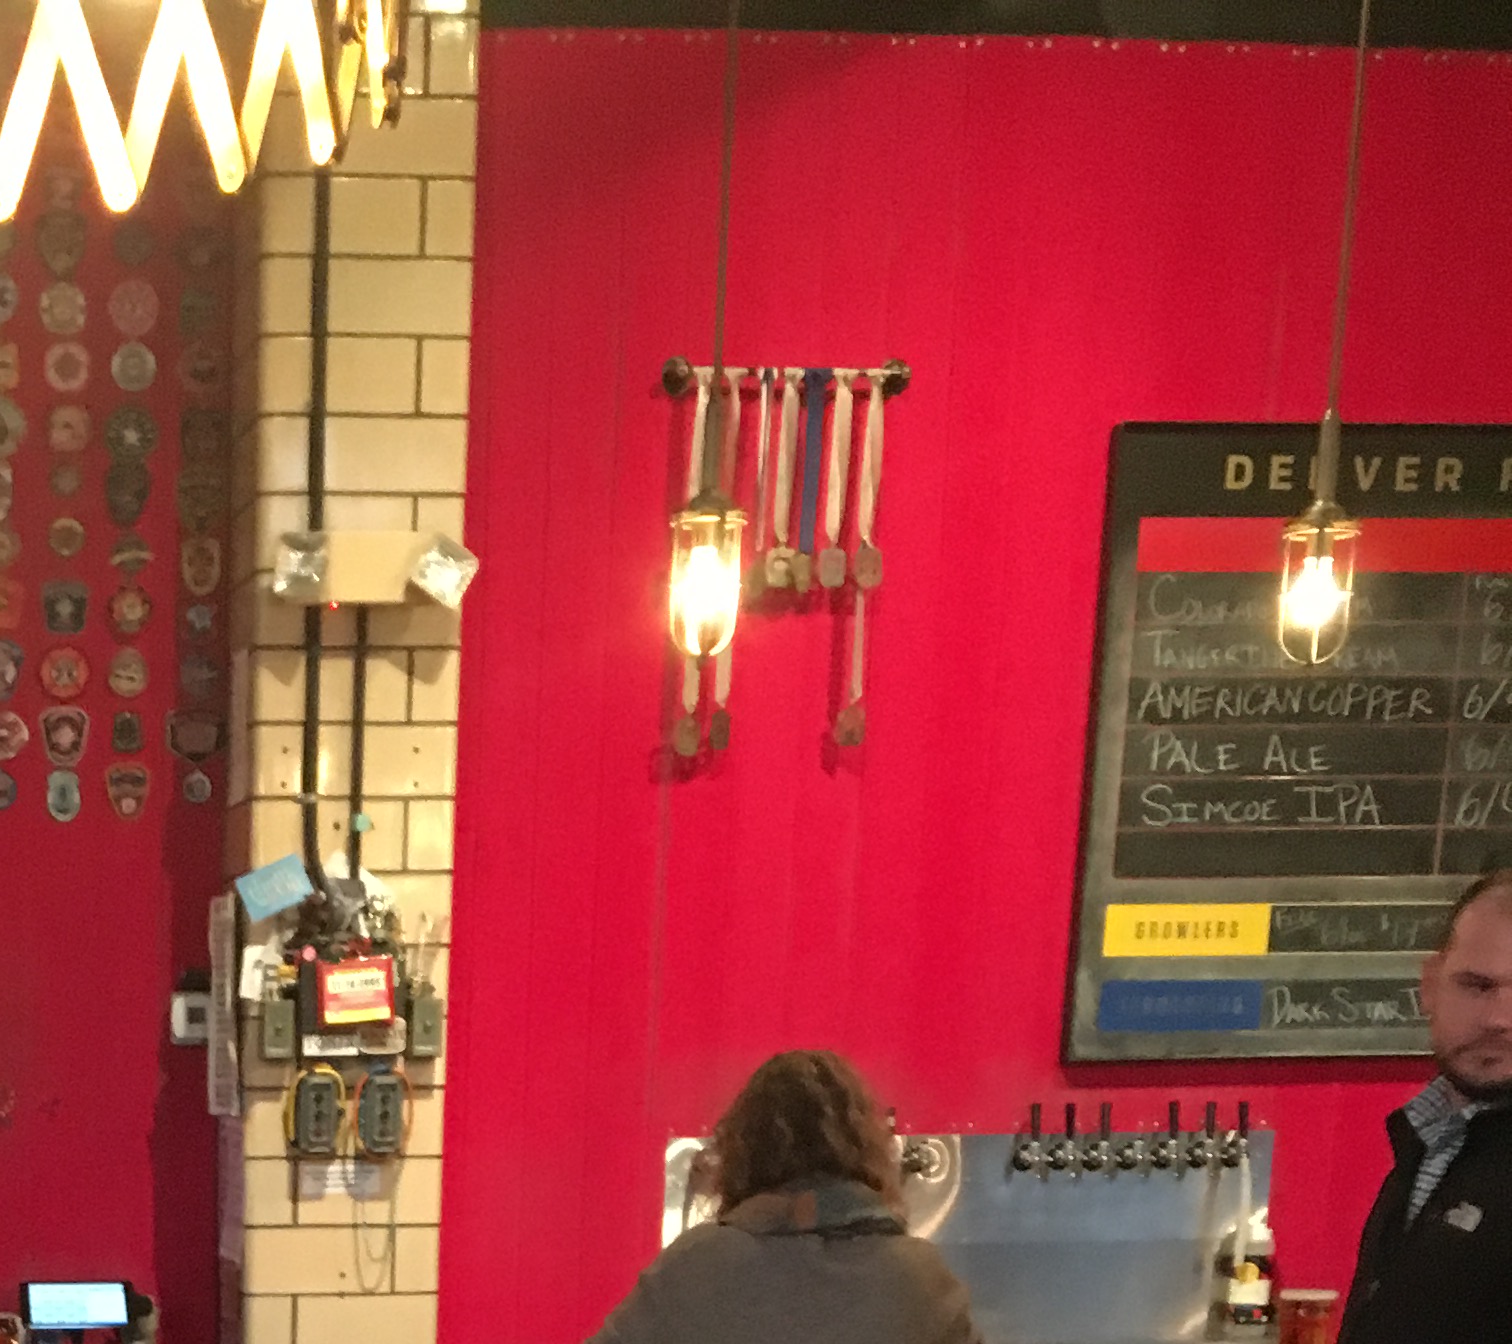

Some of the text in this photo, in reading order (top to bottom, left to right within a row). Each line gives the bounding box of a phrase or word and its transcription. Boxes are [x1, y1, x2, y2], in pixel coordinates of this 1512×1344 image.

[1138, 681, 1434, 721] AMERICAN COPPER
[1141, 729, 1333, 773] PALE ALE
[1140, 784, 1382, 827] SIMCOE IPA
[1134, 920, 1240, 940] GROWLERS
